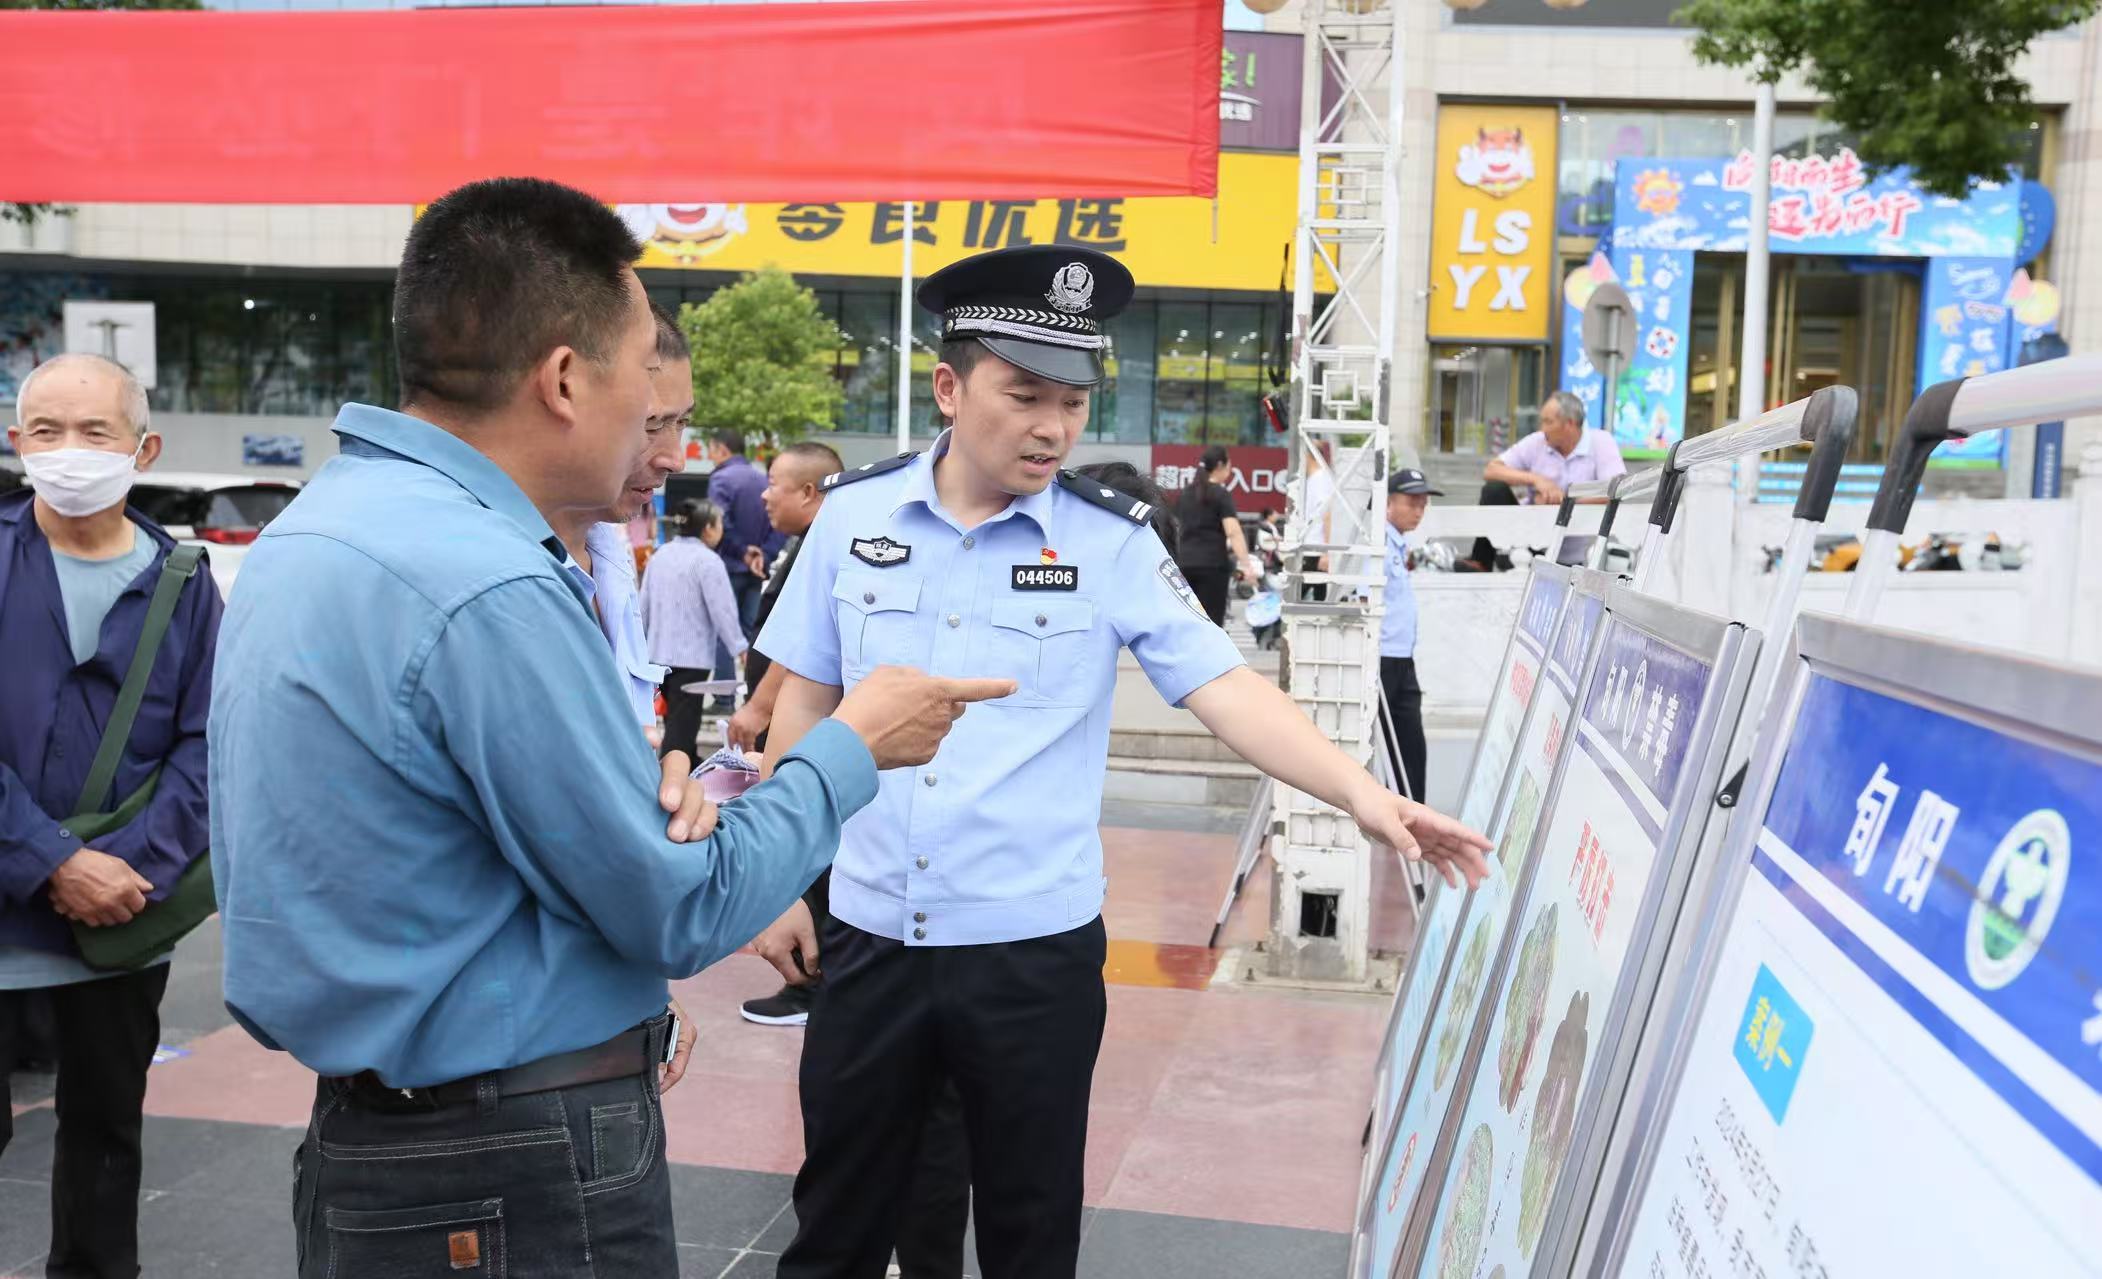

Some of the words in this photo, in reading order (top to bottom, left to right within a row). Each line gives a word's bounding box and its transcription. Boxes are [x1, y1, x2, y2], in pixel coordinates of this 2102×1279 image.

[1459, 207, 1532, 255] LS
[1448, 265, 1532, 311] YX
[1016, 570, 1073, 585] 044506
[1844, 762, 1960, 913] 旬阳
